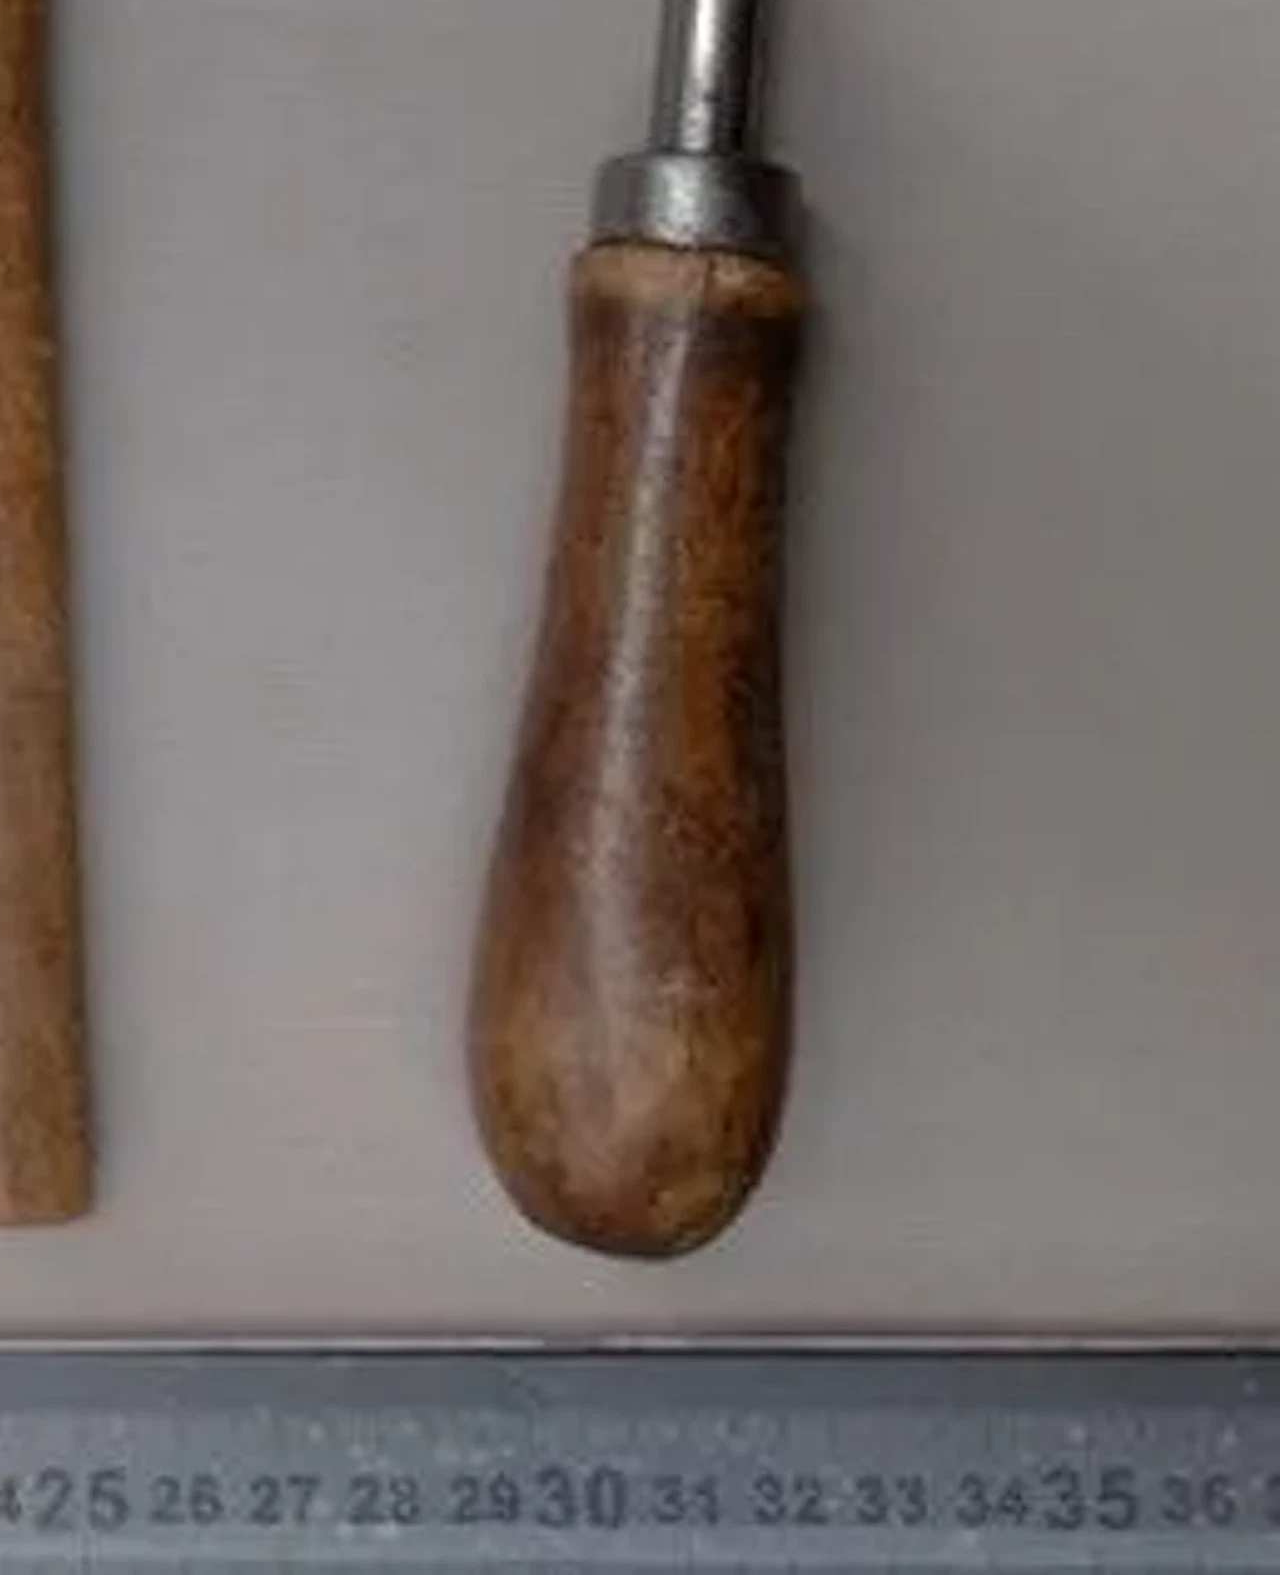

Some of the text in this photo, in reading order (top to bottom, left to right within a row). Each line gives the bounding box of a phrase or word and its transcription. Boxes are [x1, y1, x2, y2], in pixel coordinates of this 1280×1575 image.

[37, 1467, 131, 1530] 25
[150, 1474, 224, 1523] 26
[249, 1475, 321, 1524] 27
[349, 1476, 421, 1524] 28
[451, 1471, 521, 1524] 29
[535, 1465, 628, 1529] 30
[652, 1475, 721, 1525] 31
[754, 1472, 828, 1525] 32
[856, 1475, 927, 1525] 33
[957, 1474, 1031, 1526] 34
[1042, 1465, 1139, 1530] 35
[1162, 1474, 1236, 1526] 36
